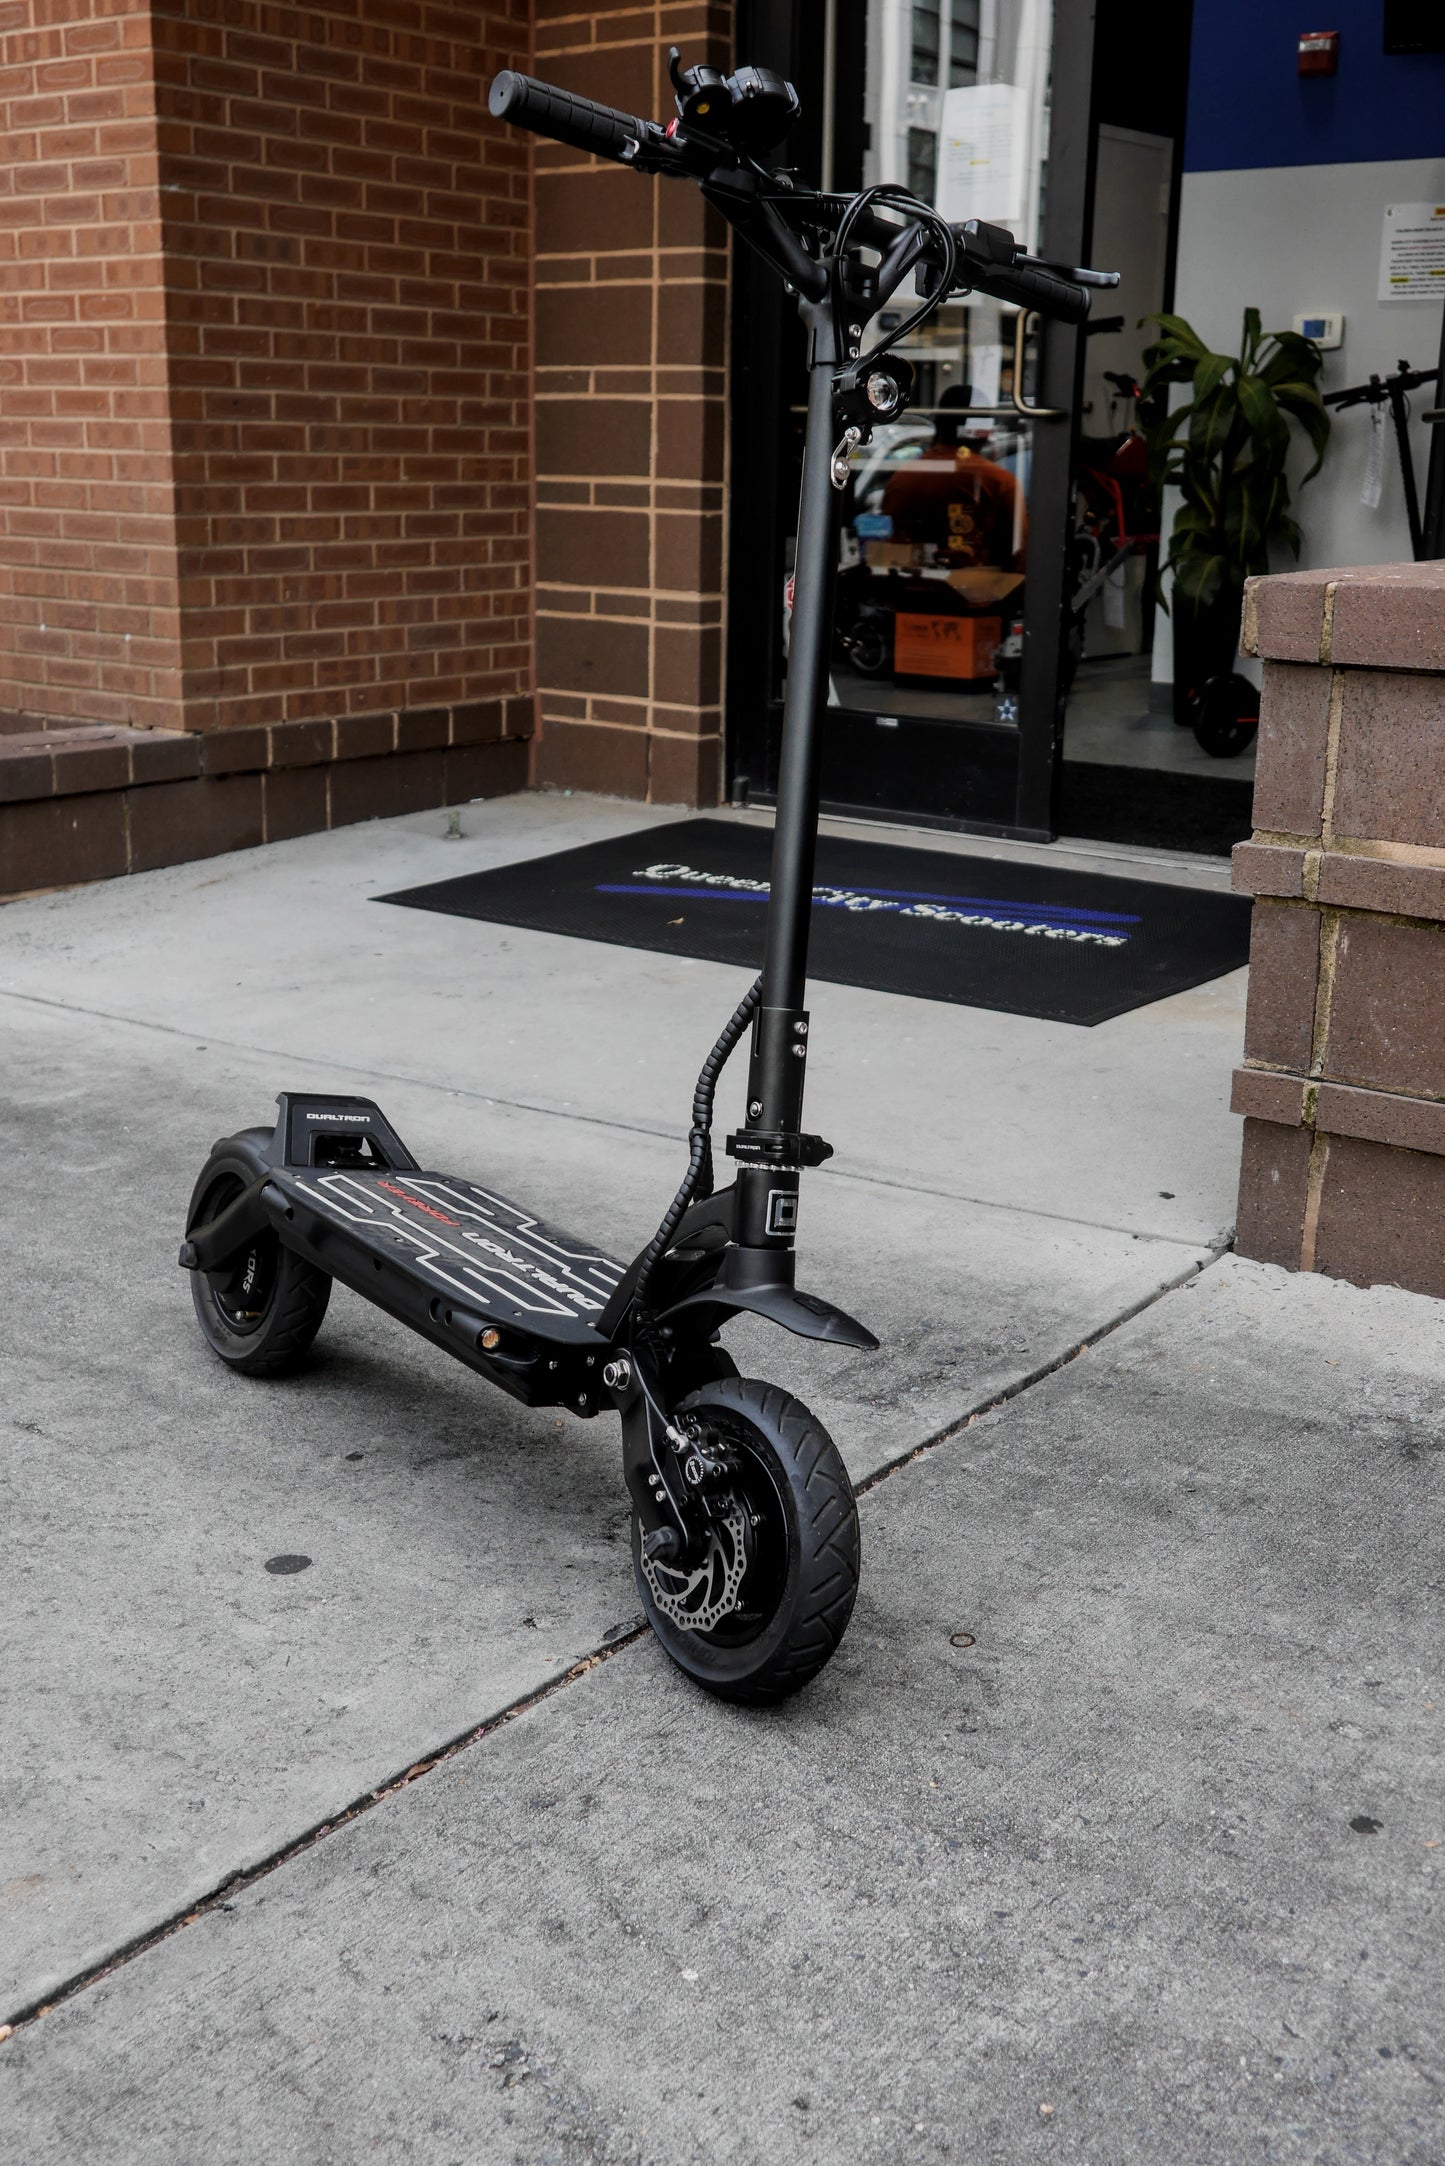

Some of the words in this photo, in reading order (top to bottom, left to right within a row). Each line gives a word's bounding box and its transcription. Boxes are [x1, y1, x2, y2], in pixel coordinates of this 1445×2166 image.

[899, 902, 1129, 947] Scooters
[306, 1112, 371, 1123] DUALTRON
[461, 1232, 605, 1310] DUALTRON
